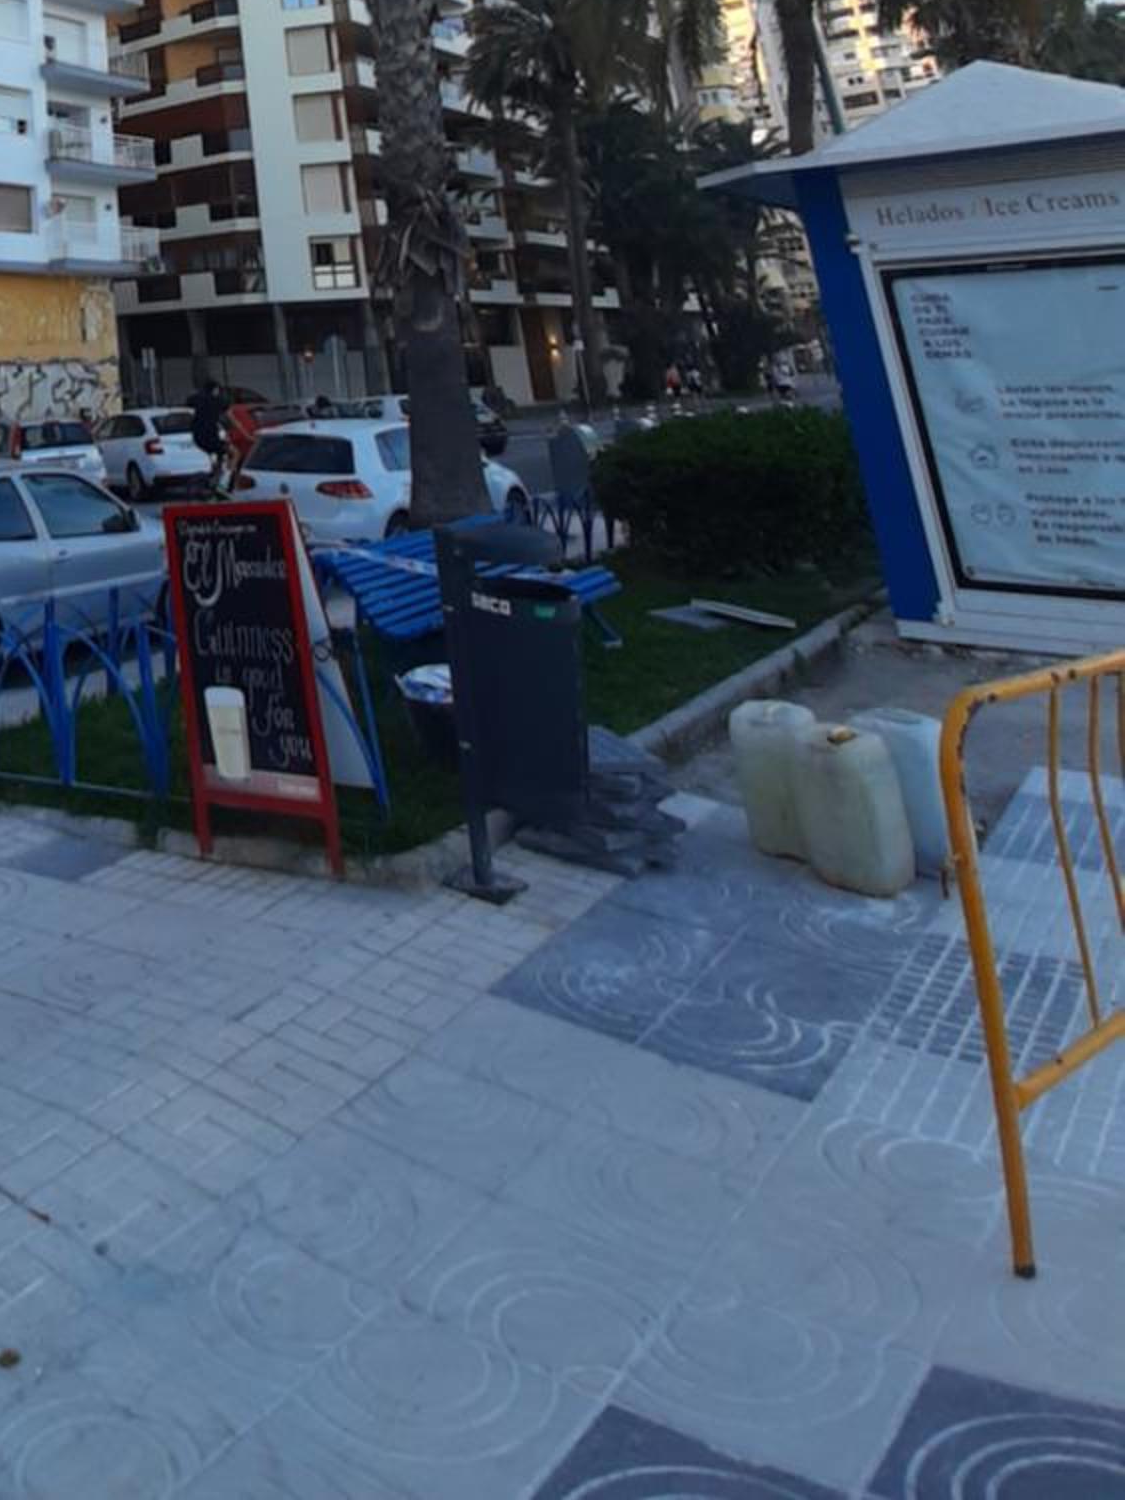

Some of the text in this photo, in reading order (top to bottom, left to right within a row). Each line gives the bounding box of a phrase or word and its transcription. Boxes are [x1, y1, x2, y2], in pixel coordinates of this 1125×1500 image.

[876, 203, 964, 227] Helados
[982, 196, 1021, 218] Ice
[1026, 191, 1121, 214] Creams
[193, 609, 295, 666] Guinness
